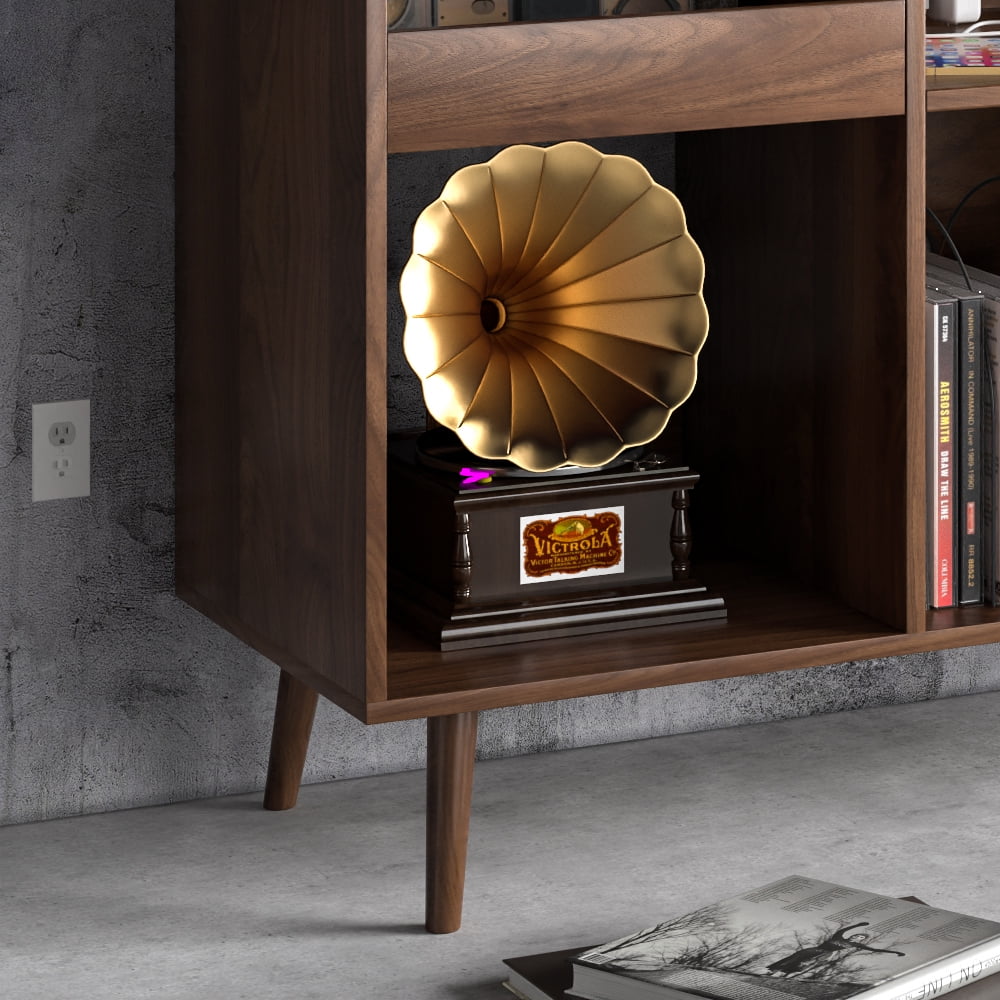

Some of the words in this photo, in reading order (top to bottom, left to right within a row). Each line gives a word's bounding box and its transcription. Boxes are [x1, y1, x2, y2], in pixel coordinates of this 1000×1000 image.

[967, 308, 975, 363] ANNIHILATOR
[940, 381, 950, 443] AEROSMITH
[967, 381, 975, 425] COMMAND
[940, 451, 949, 477] DRAW
[940, 480, 949, 497] THE
[940, 500, 949, 520] LINE
[529, 524, 615, 557] VICTROLA
